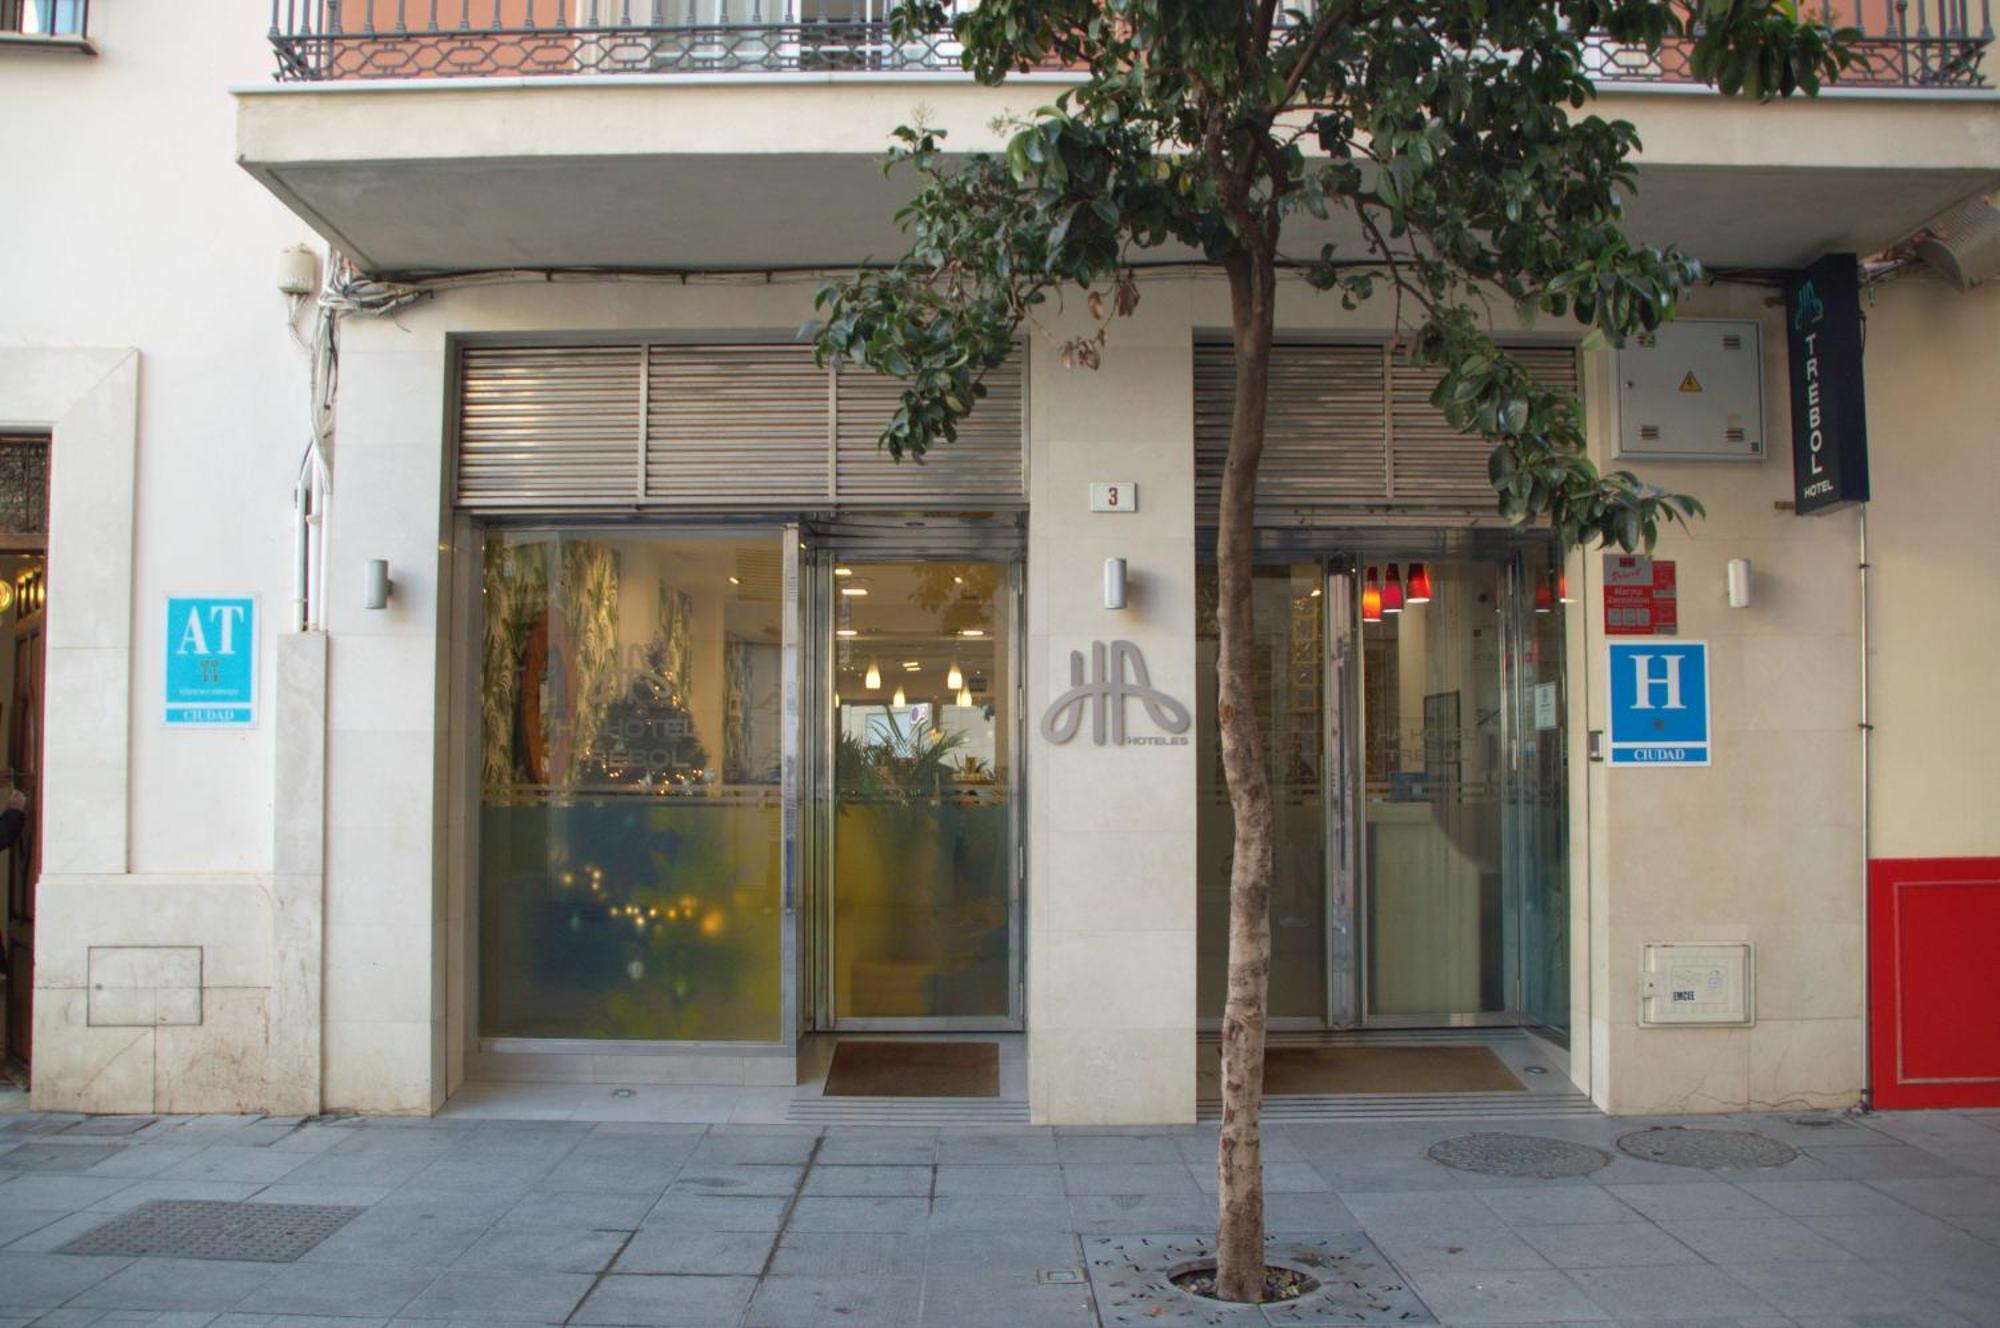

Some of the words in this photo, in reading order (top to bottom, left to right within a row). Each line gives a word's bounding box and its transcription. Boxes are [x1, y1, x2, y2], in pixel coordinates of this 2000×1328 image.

[1805, 333, 1823, 475] TREBOL
[1108, 487, 1118, 506] 3
[1804, 480, 1834, 499] HOTEL
[176, 604, 245, 655] AT
[1628, 653, 1688, 710] H
[182, 710, 235, 721] CIUDAD
[1127, 735, 1189, 746] HOTELES
[1633, 748, 1686, 761] CIUDAD
